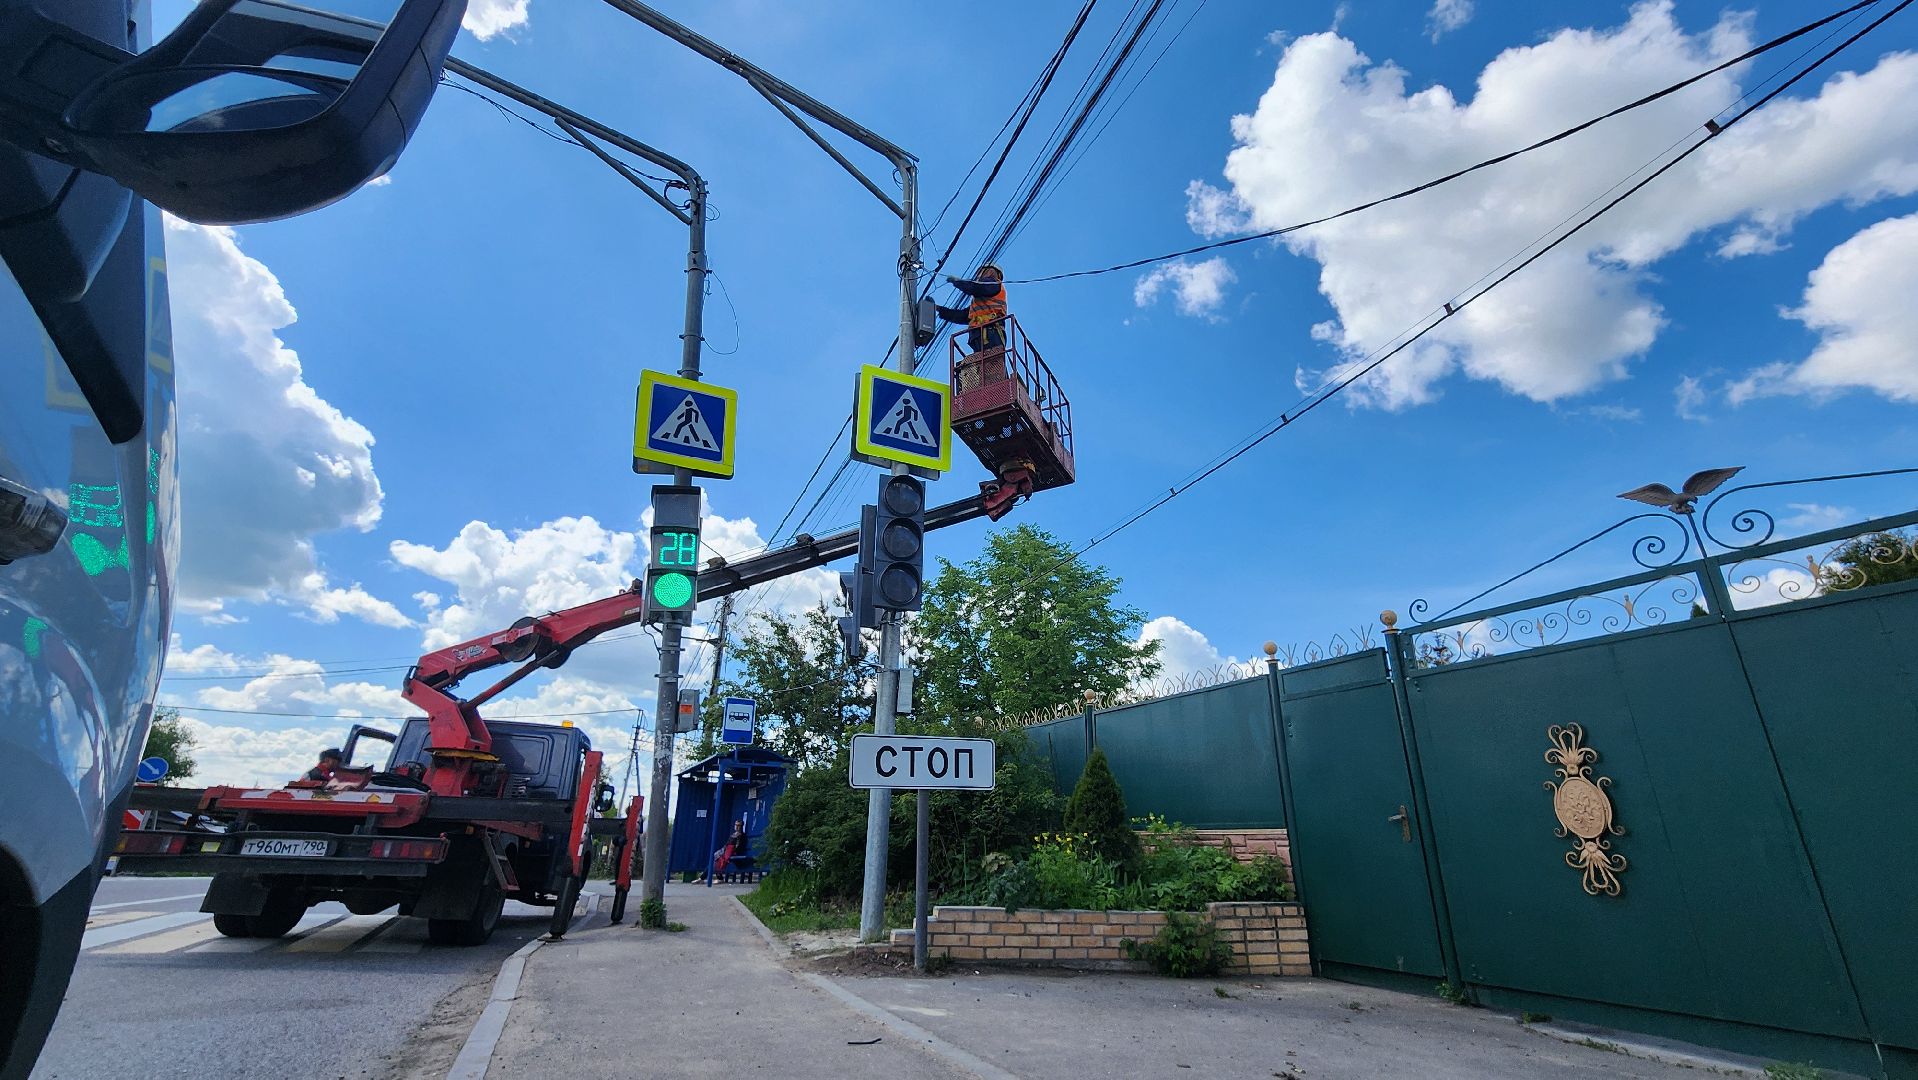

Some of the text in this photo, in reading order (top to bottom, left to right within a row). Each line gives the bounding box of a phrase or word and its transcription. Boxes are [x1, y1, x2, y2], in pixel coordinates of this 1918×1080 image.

[660, 532, 696, 565] 28
[875, 745, 973, 779] СТОП
[303, 840, 324, 851] 790
